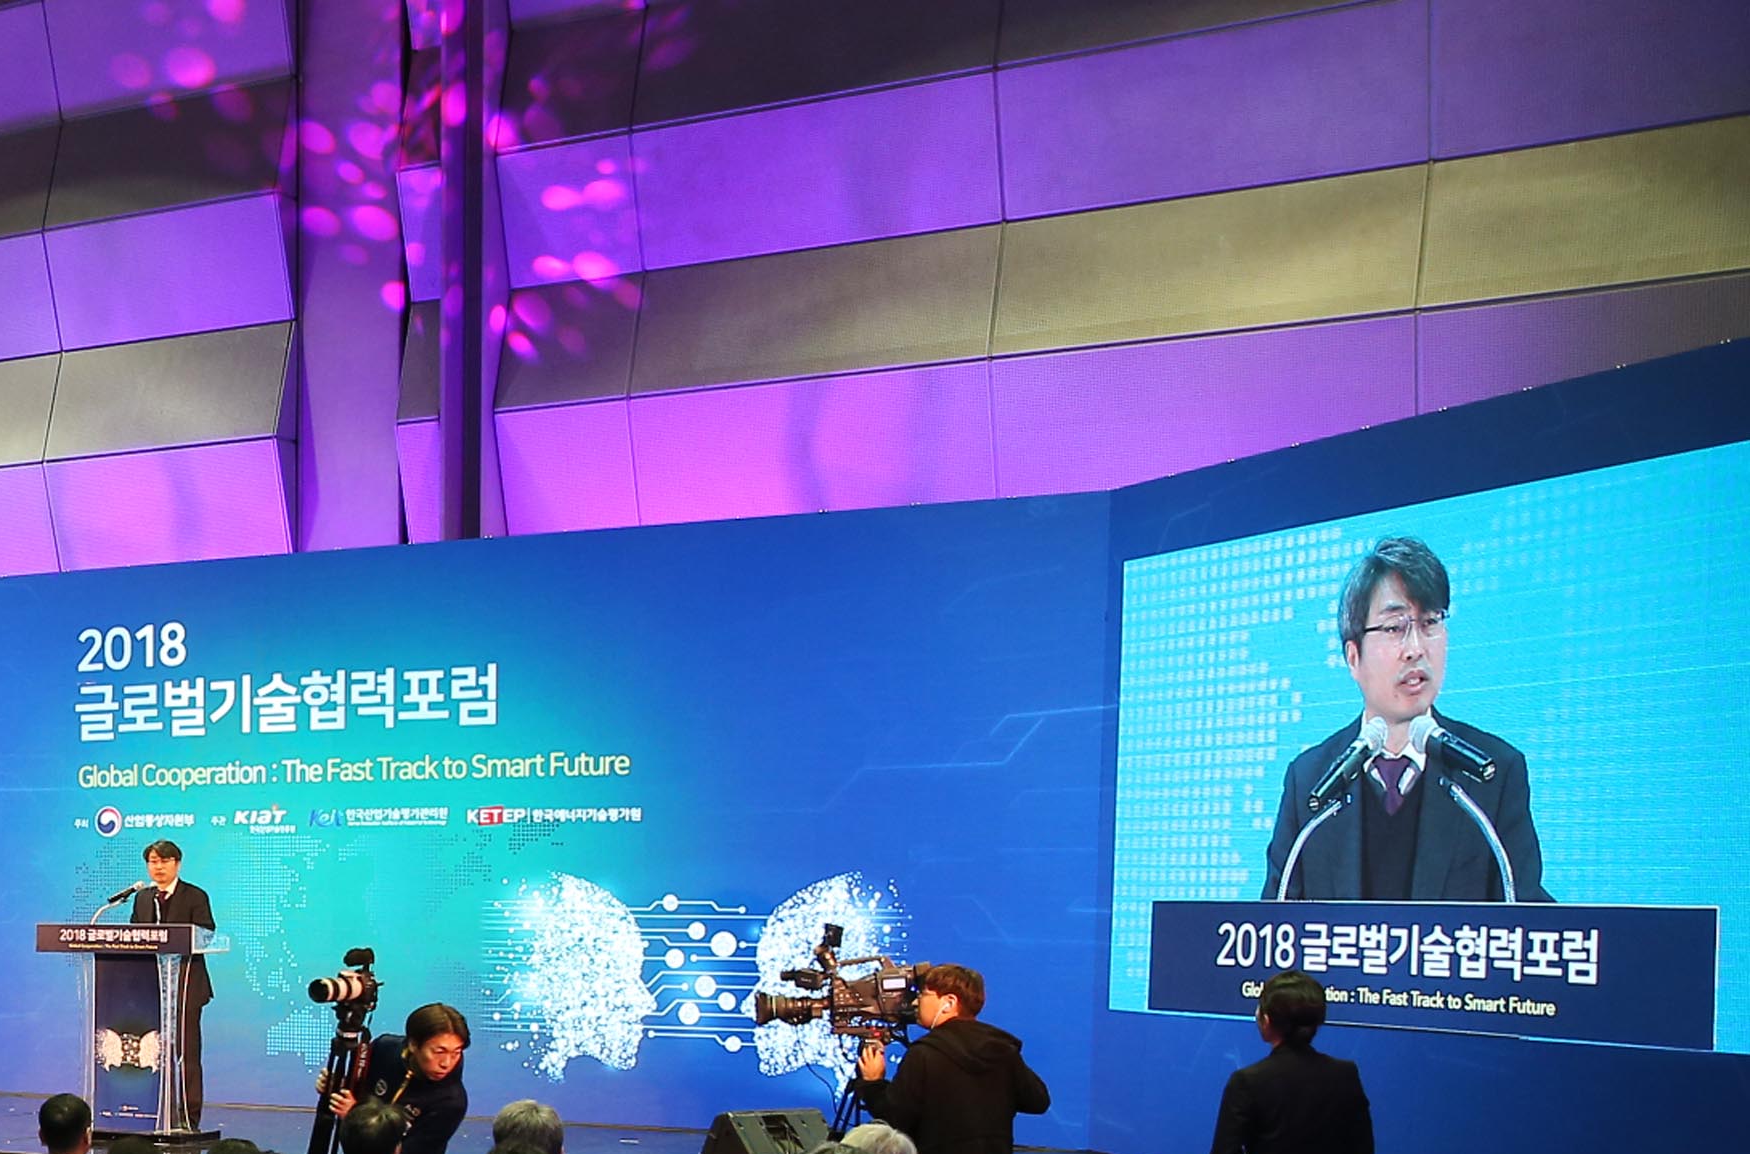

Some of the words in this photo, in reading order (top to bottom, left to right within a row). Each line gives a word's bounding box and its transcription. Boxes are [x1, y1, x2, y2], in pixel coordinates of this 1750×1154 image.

[76, 620, 187, 673] 2018
[74, 662, 499, 742] 글로벌기술협력포럼
[78, 764, 139, 788] Global
[142, 761, 266, 791] Cooperation
[271, 762, 278, 782] :
[281, 759, 323, 783] The
[327, 757, 374, 782] Fast
[377, 754, 439, 781] Track
[442, 756, 468, 779] to
[471, 753, 546, 779] Smart
[550, 751, 631, 777] Future
[467, 807, 526, 825] KETEP
[59, 929, 87, 942] 2018
[1215, 921, 1296, 969] 2018
[1300, 921, 1600, 986] 글로벌기술협력포럼
[1357, 987, 1380, 1005] The
[1382, 989, 1408, 1006] Fast
[1412, 991, 1445, 1009] Track
[1447, 993, 1462, 1010] to
[1464, 992, 1505, 1013] Smart
[1508, 995, 1556, 1017] Future
